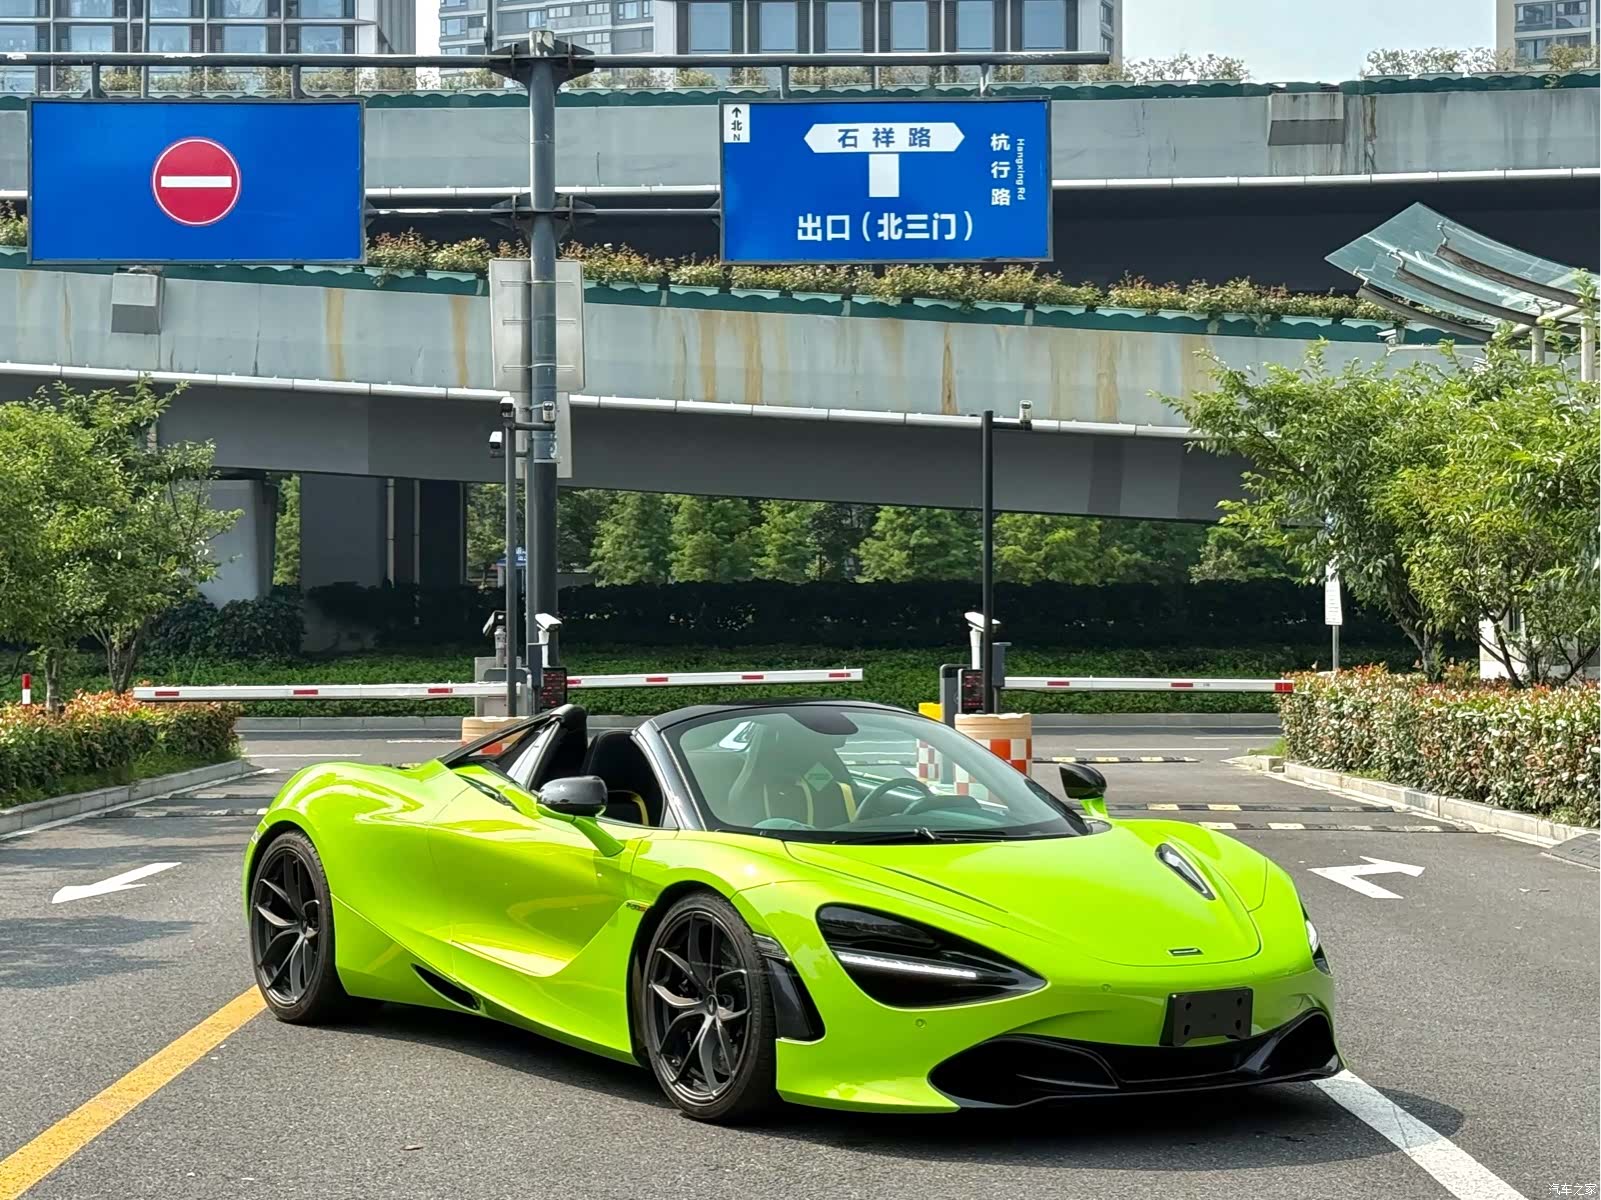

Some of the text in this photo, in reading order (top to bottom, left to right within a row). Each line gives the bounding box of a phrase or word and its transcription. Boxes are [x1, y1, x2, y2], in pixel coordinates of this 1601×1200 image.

[731, 120, 743, 131] 北
[733, 133, 741, 141] N
[837, 127, 931, 149] 石祥路
[990, 132, 1011, 206] 杭行路
[1015, 138, 1026, 201] Hangxing Rd
